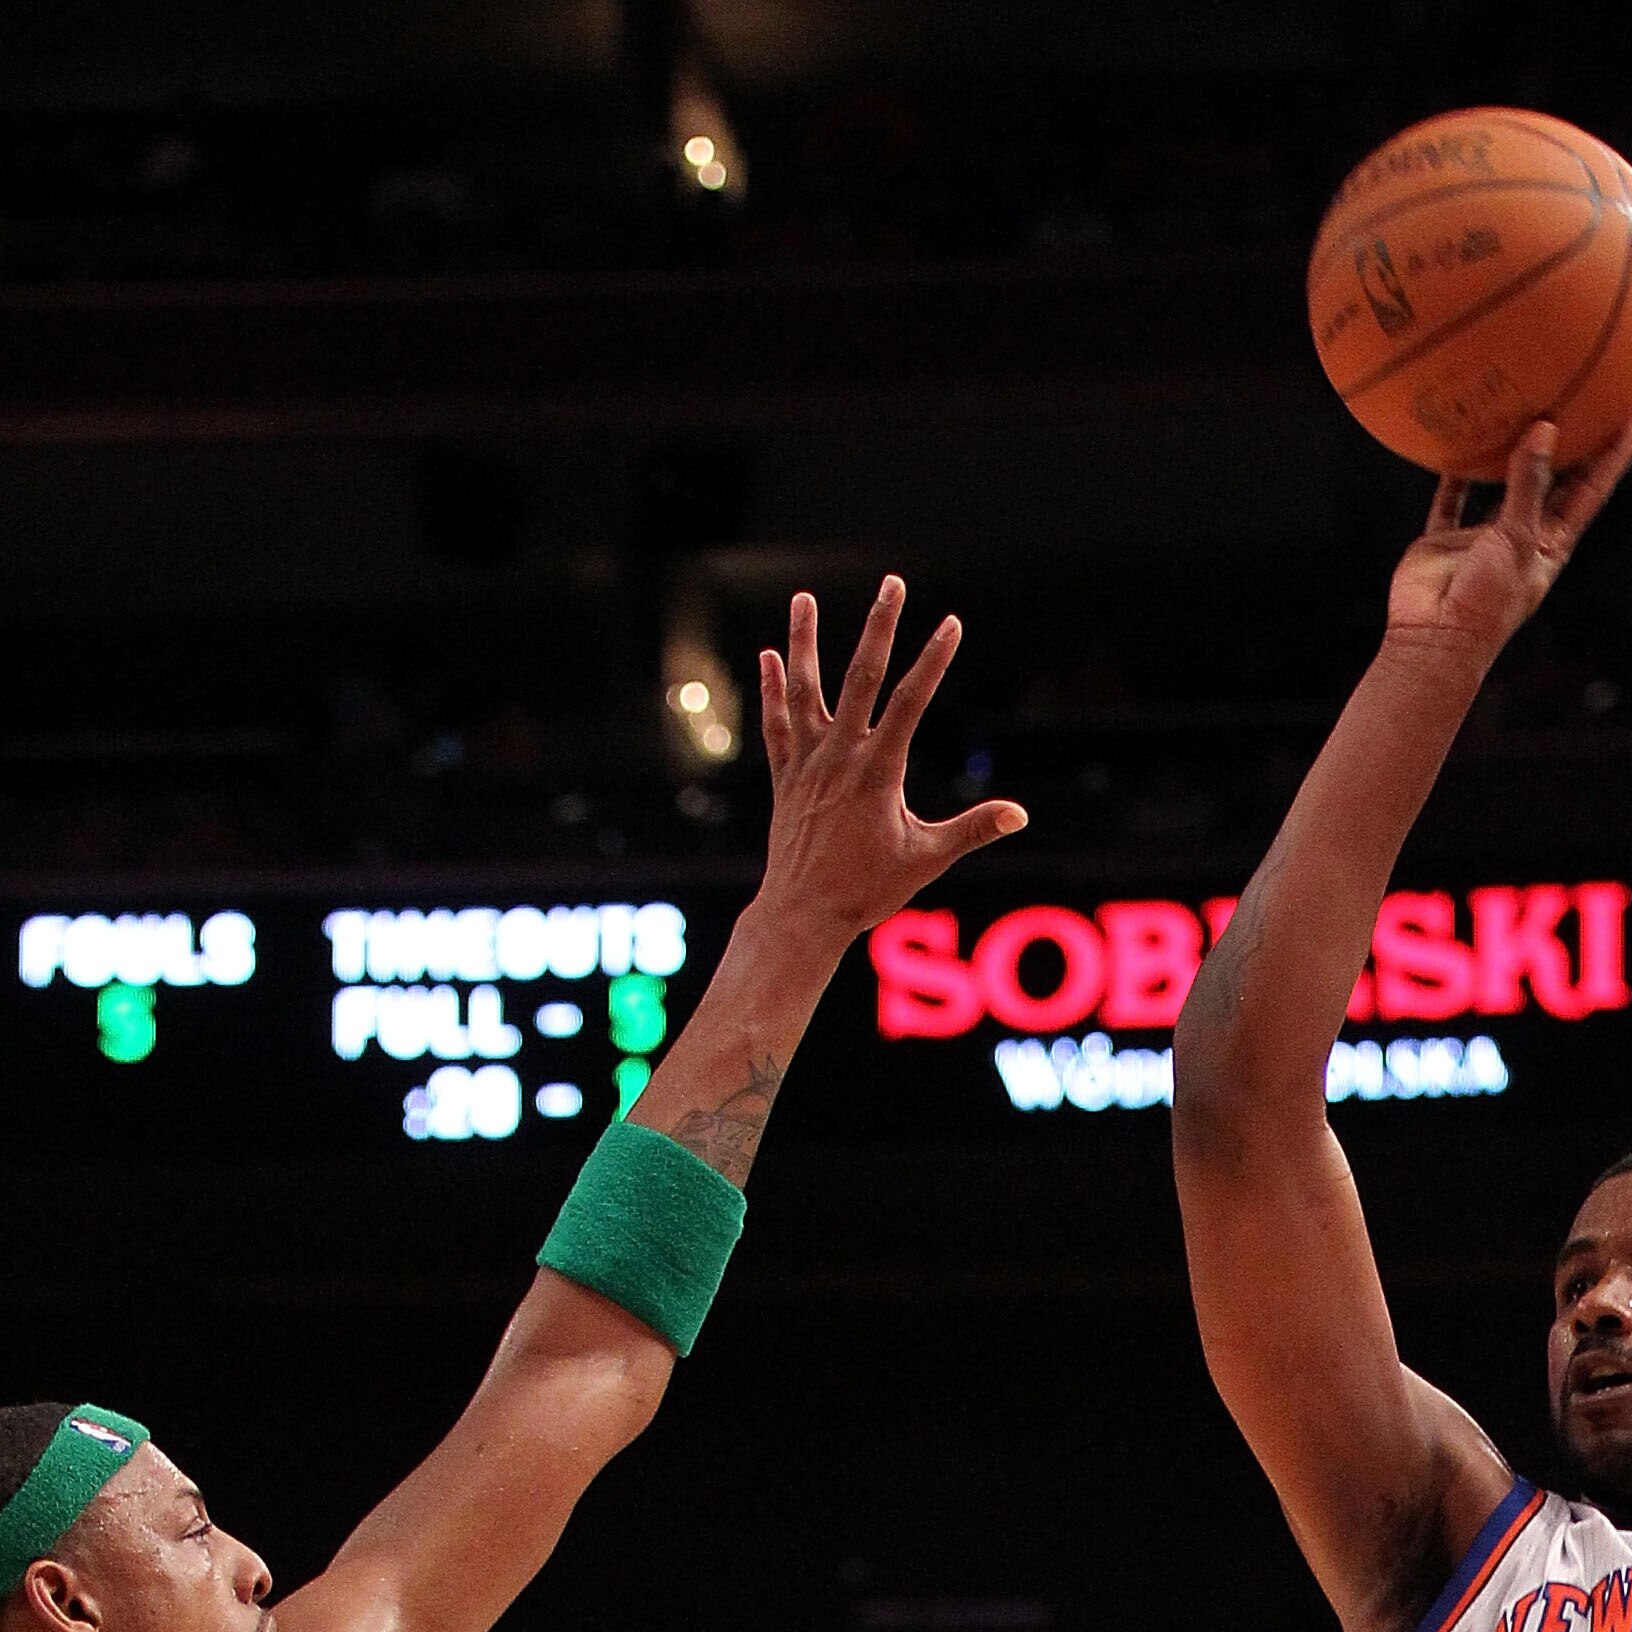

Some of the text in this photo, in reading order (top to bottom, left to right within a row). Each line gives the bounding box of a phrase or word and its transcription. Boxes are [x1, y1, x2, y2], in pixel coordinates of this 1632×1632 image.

[19, 912, 256, 987] FOULS
[323, 903, 687, 983] TIMEOUTS
[868, 881, 1632, 1040] SOBSKI
[332, 985, 522, 1060] FULL
